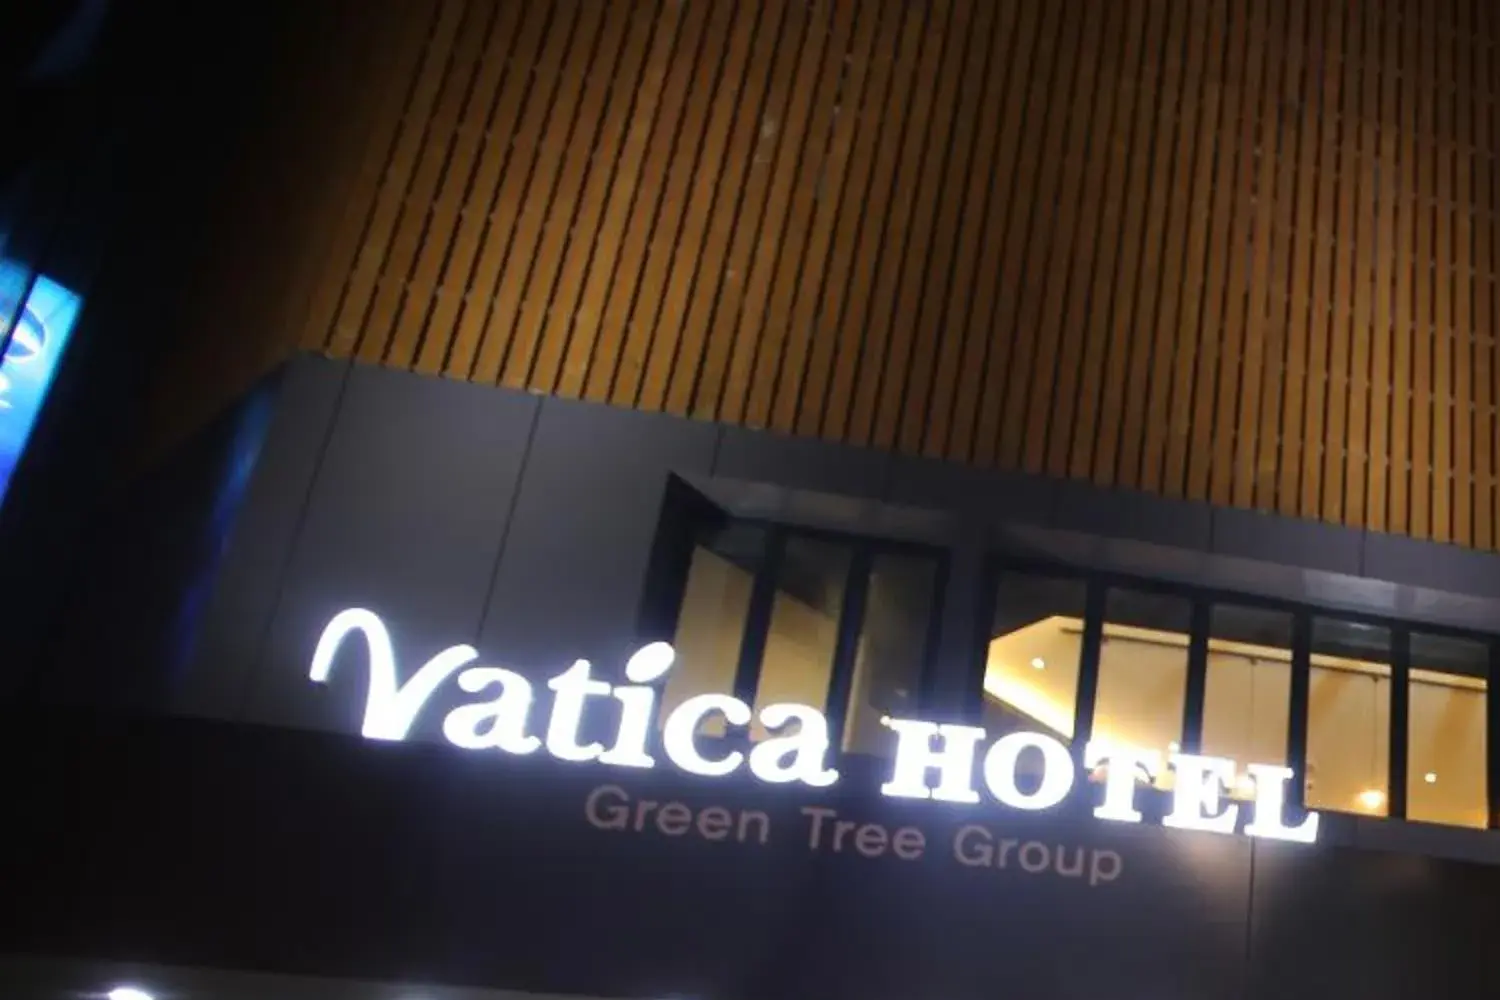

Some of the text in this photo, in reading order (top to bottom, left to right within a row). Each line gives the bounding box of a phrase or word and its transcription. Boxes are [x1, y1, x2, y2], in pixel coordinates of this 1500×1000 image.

[309, 607, 1320, 842] Vatica HOTEL
[584, 784, 1124, 886] Green Tree Group
